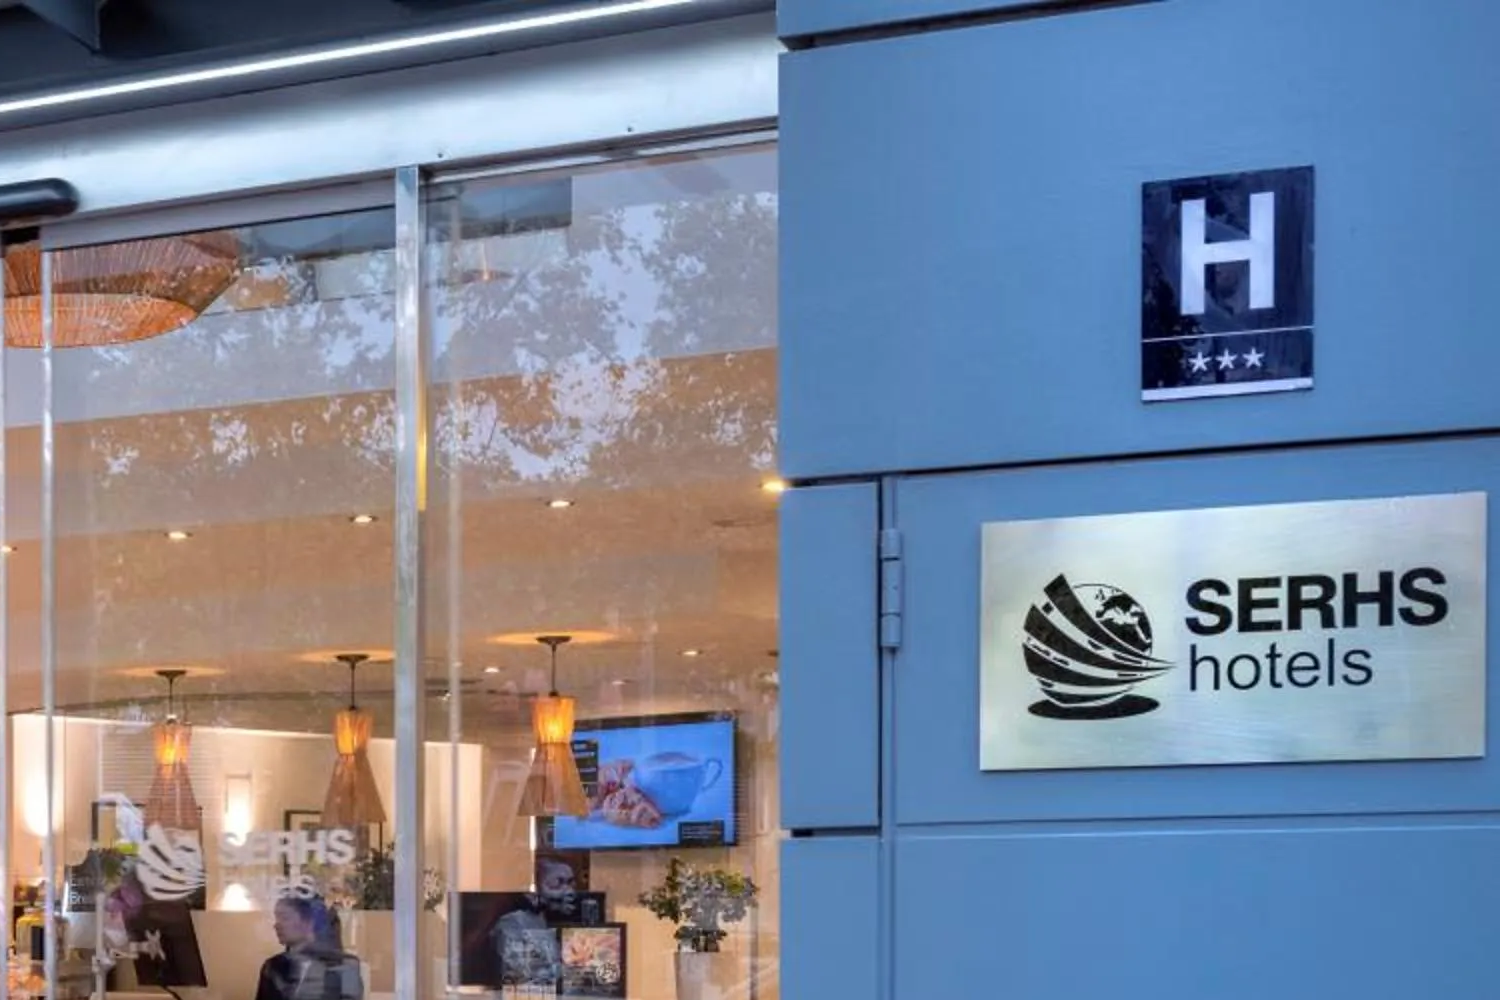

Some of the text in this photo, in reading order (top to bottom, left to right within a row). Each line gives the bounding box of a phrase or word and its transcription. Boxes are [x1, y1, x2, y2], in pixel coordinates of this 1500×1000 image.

[1180, 191, 1275, 315] H
[1184, 566, 1449, 637] SERHS
[1189, 637, 1374, 692] hotels
[217, 828, 357, 867] SERHS
